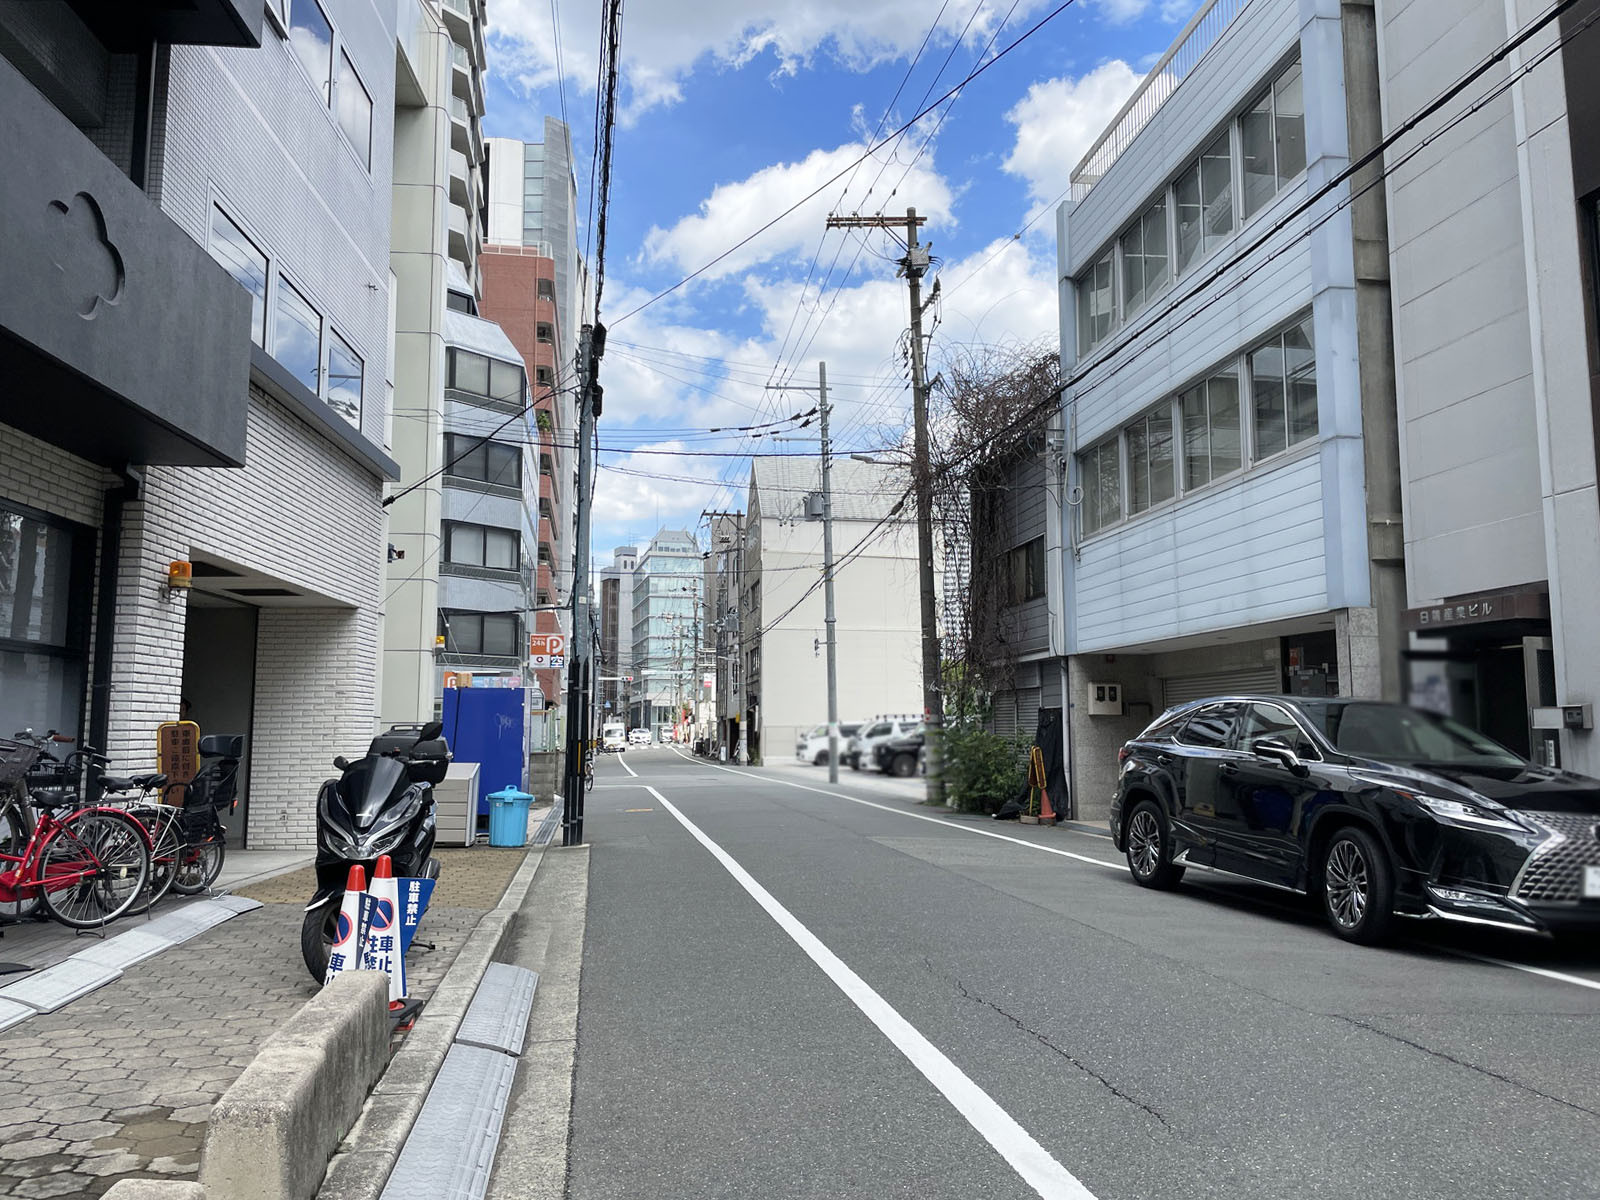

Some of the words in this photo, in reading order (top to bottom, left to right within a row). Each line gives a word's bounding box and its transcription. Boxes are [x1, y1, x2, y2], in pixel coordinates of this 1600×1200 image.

[546, 636, 564, 654] P
[405, 881, 421, 926] 駐車禁止
